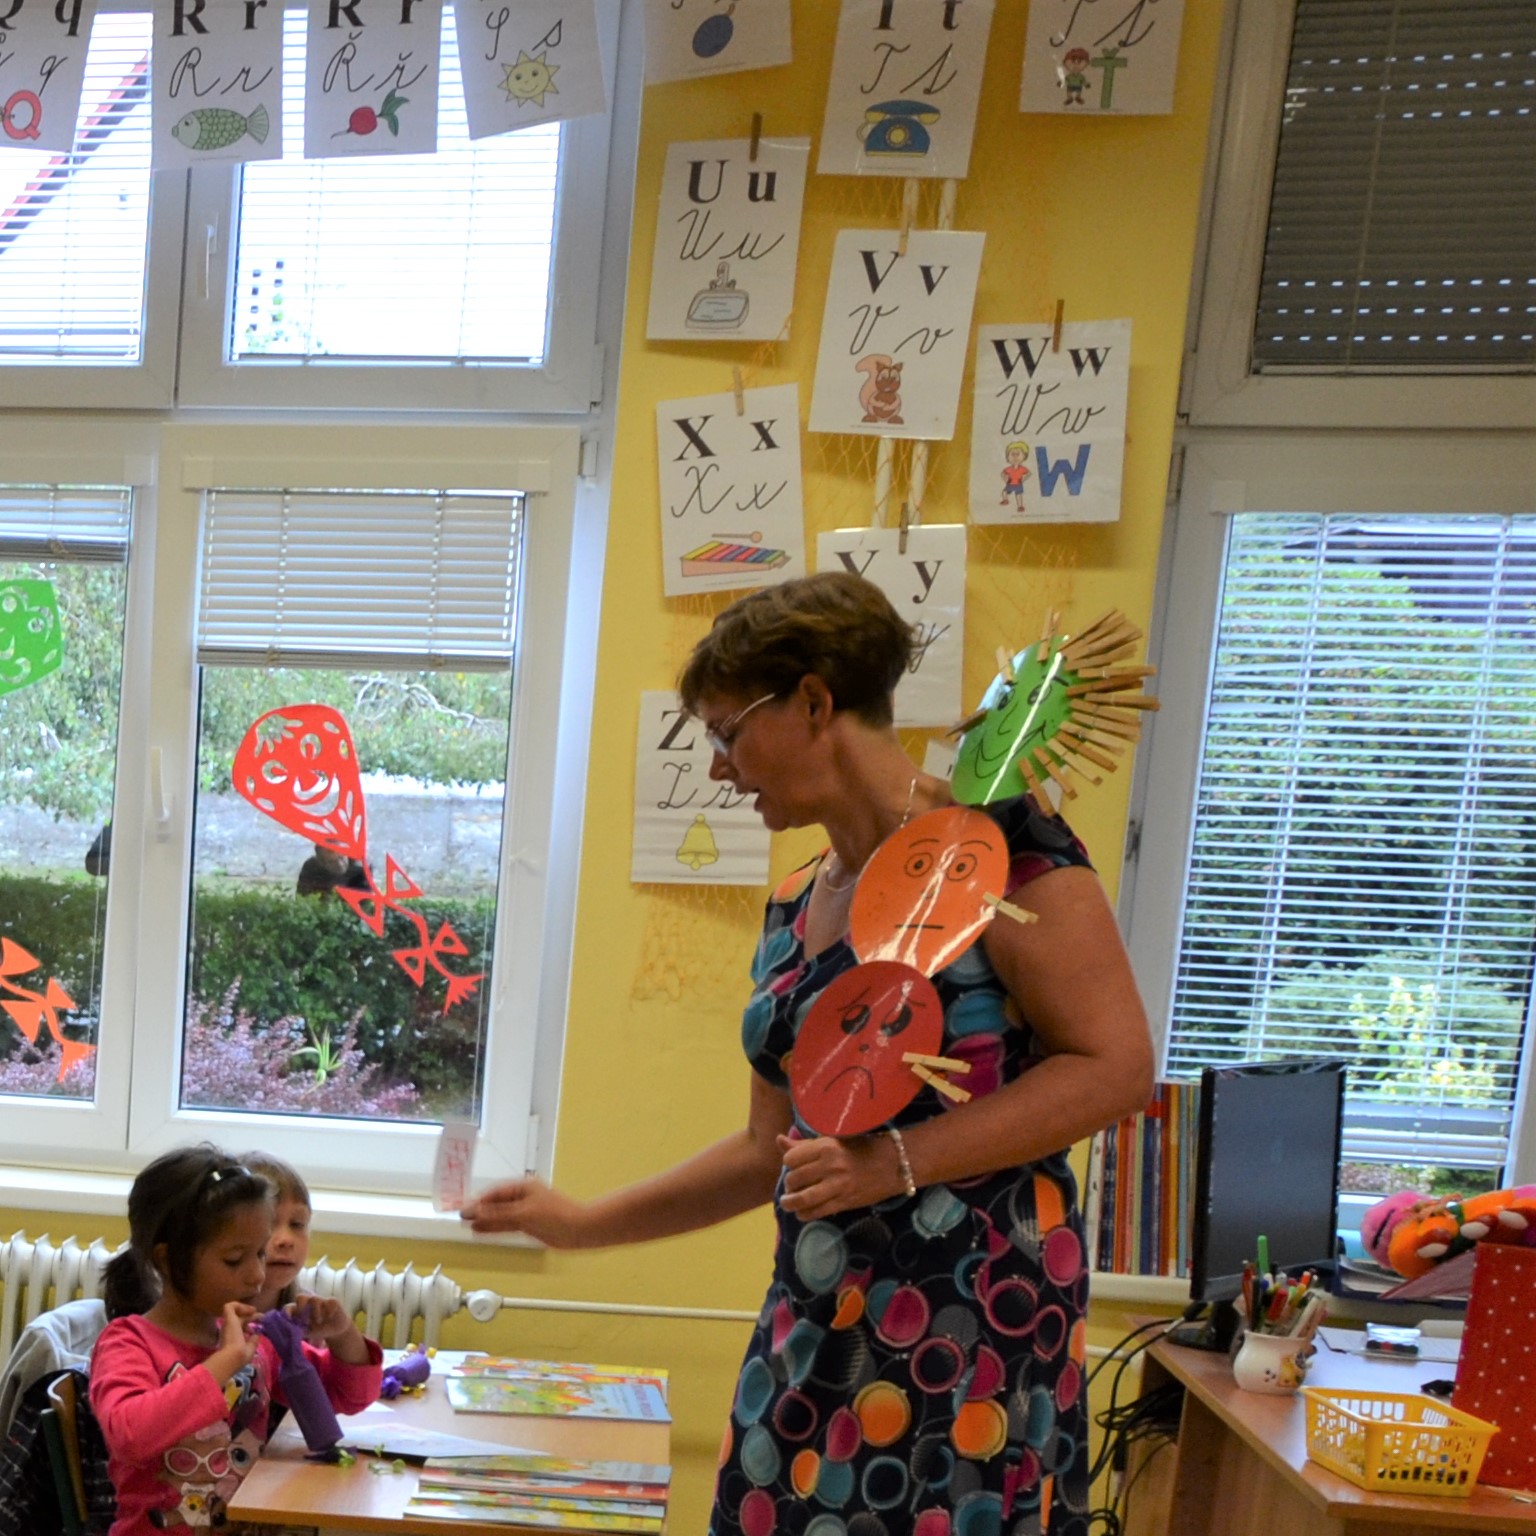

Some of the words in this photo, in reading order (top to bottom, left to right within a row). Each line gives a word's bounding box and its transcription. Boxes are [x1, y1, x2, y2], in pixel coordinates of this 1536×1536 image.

[55, 0, 84, 37] q
[169, 0, 211, 37] R
[243, 0, 268, 30] r
[687, 160, 729, 203] U
[747, 171, 777, 203] u
[859, 250, 900, 295] V
[919, 265, 950, 296] v
[992, 337, 1051, 380] W
[1067, 346, 1112, 377] w
[672, 415, 717, 461] X
[750, 419, 779, 452] x
[912, 560, 944, 604] y
[657, 710, 698, 750] Z
